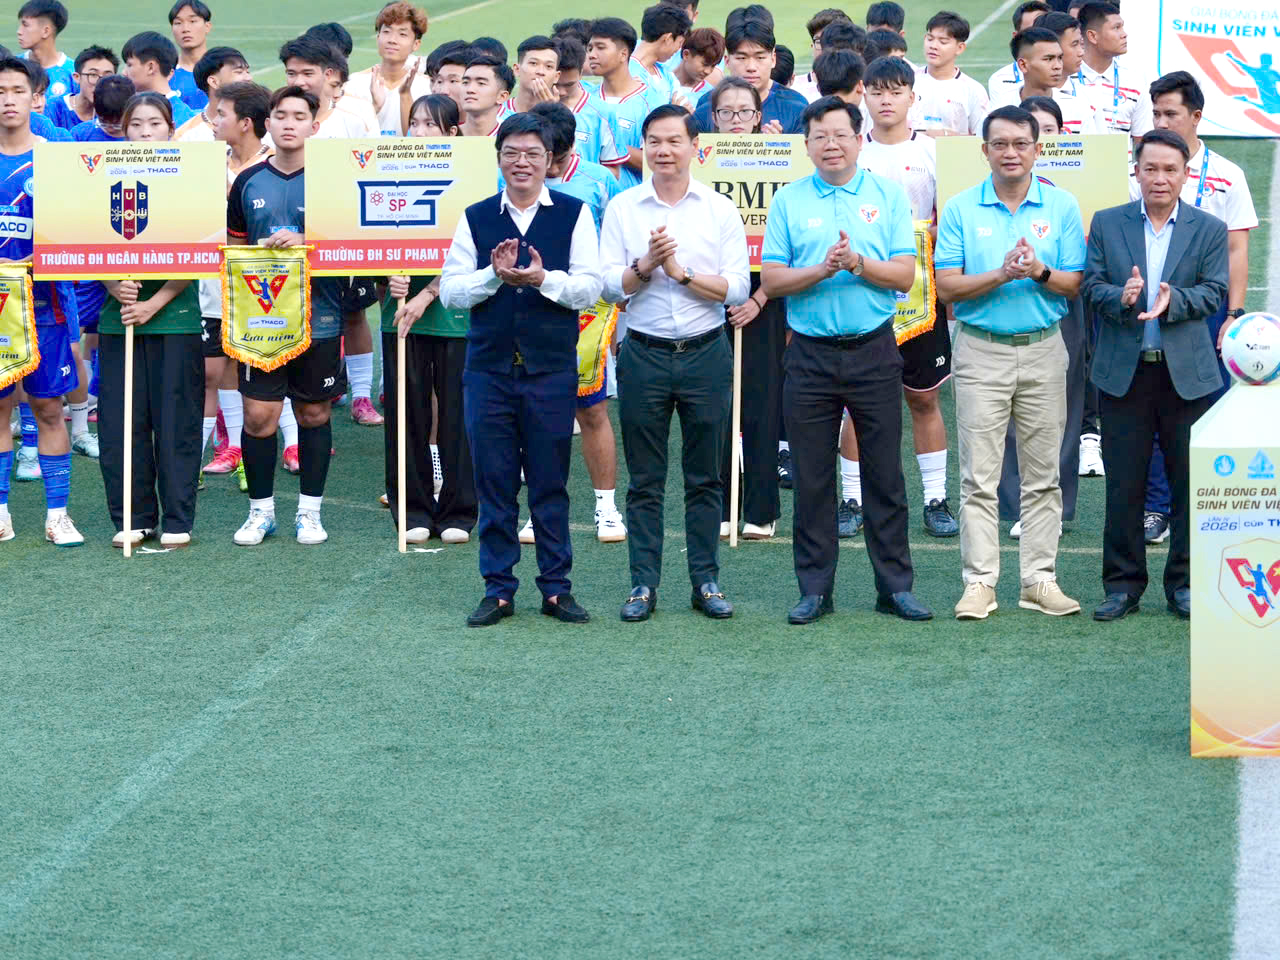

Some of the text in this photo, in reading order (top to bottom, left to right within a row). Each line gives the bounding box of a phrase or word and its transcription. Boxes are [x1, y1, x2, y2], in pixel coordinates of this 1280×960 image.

[1172, 19, 1217, 35] SINH
[1223, 21, 1267, 38] VIÊN
[712, 181, 791, 209] RMI
[389, 198, 407, 212] SP
[40, 249, 220, 265] TRƯỜNG ĐH NGÂN HÀNG TP.HCM
[318, 247, 364, 262] TRƯỜNG
[367, 249, 383, 261] ĐH
[405, 248, 434, 263] PHẠM
[1196, 500, 1227, 510] SINH
[1231, 498, 1261, 510] VIÊN
[1200, 521, 1238, 531] 2026
